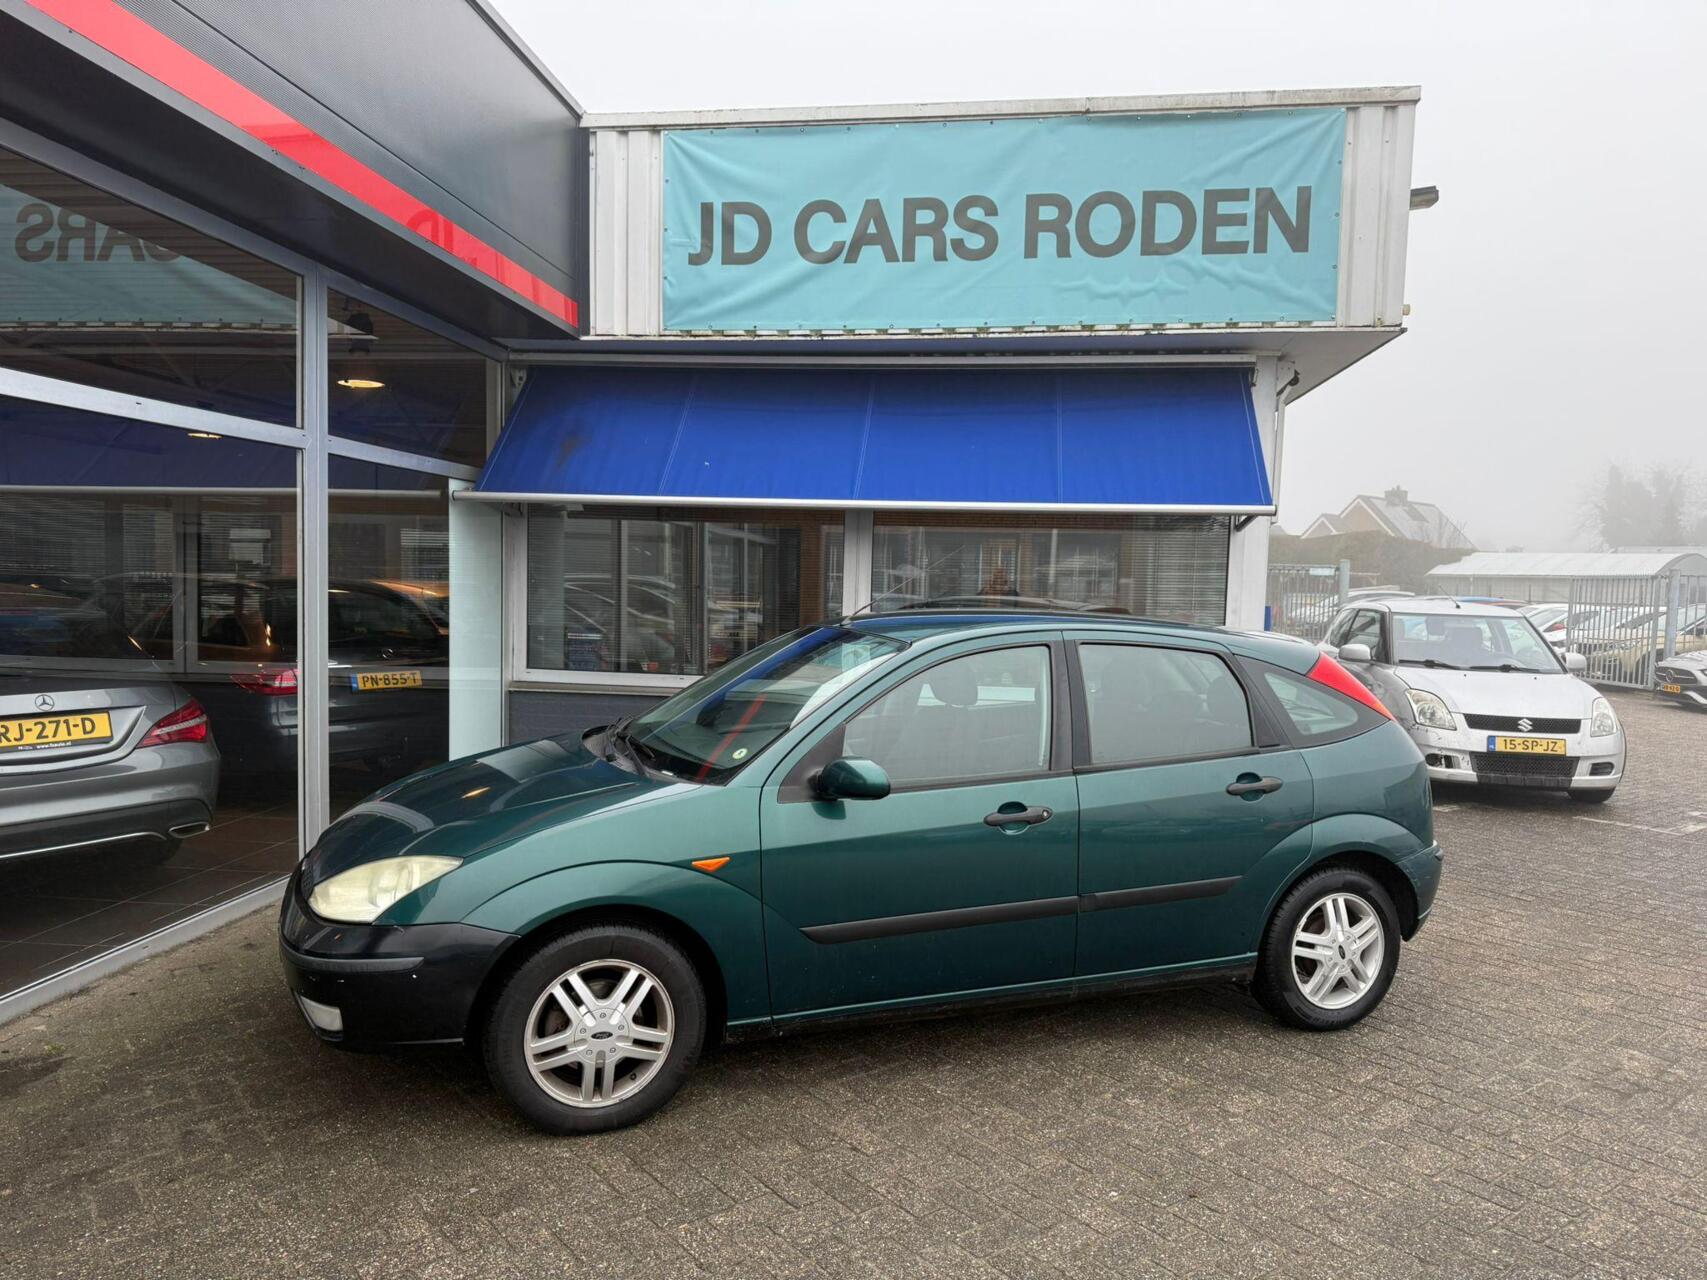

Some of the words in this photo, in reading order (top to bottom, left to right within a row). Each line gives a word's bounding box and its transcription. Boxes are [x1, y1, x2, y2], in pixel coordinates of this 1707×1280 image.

[687, 201, 772, 266] JD
[793, 194, 999, 265] CARS
[1023, 185, 1312, 259] RODEN
[361, 672, 417, 688] PN-855-T
[0, 716, 96, 743] RJ-271-D
[1503, 738, 1559, 753] 15-SP-JZ
